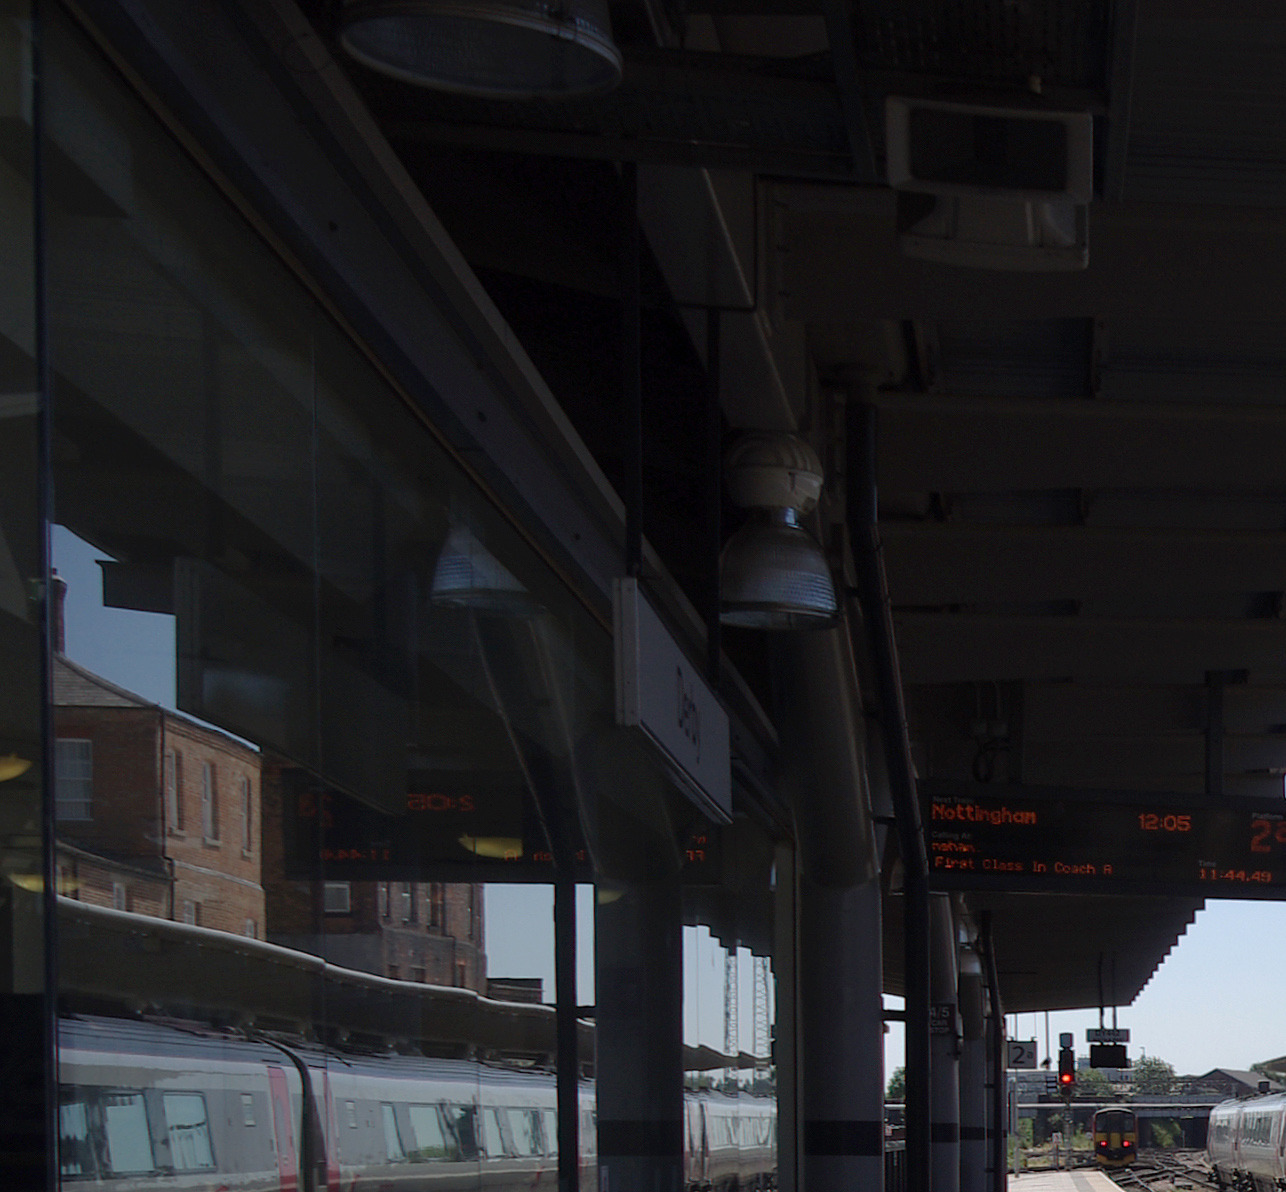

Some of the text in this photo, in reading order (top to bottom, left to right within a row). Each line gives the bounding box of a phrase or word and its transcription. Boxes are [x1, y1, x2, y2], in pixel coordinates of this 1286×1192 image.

[931, 803, 1038, 825] Nottingham
[1138, 812, 1192, 832] 12:05
[933, 855, 975, 870] First
[982, 858, 1024, 871] Class
[1054, 861, 1097, 875] Coach
[1103, 863, 1114, 875] A
